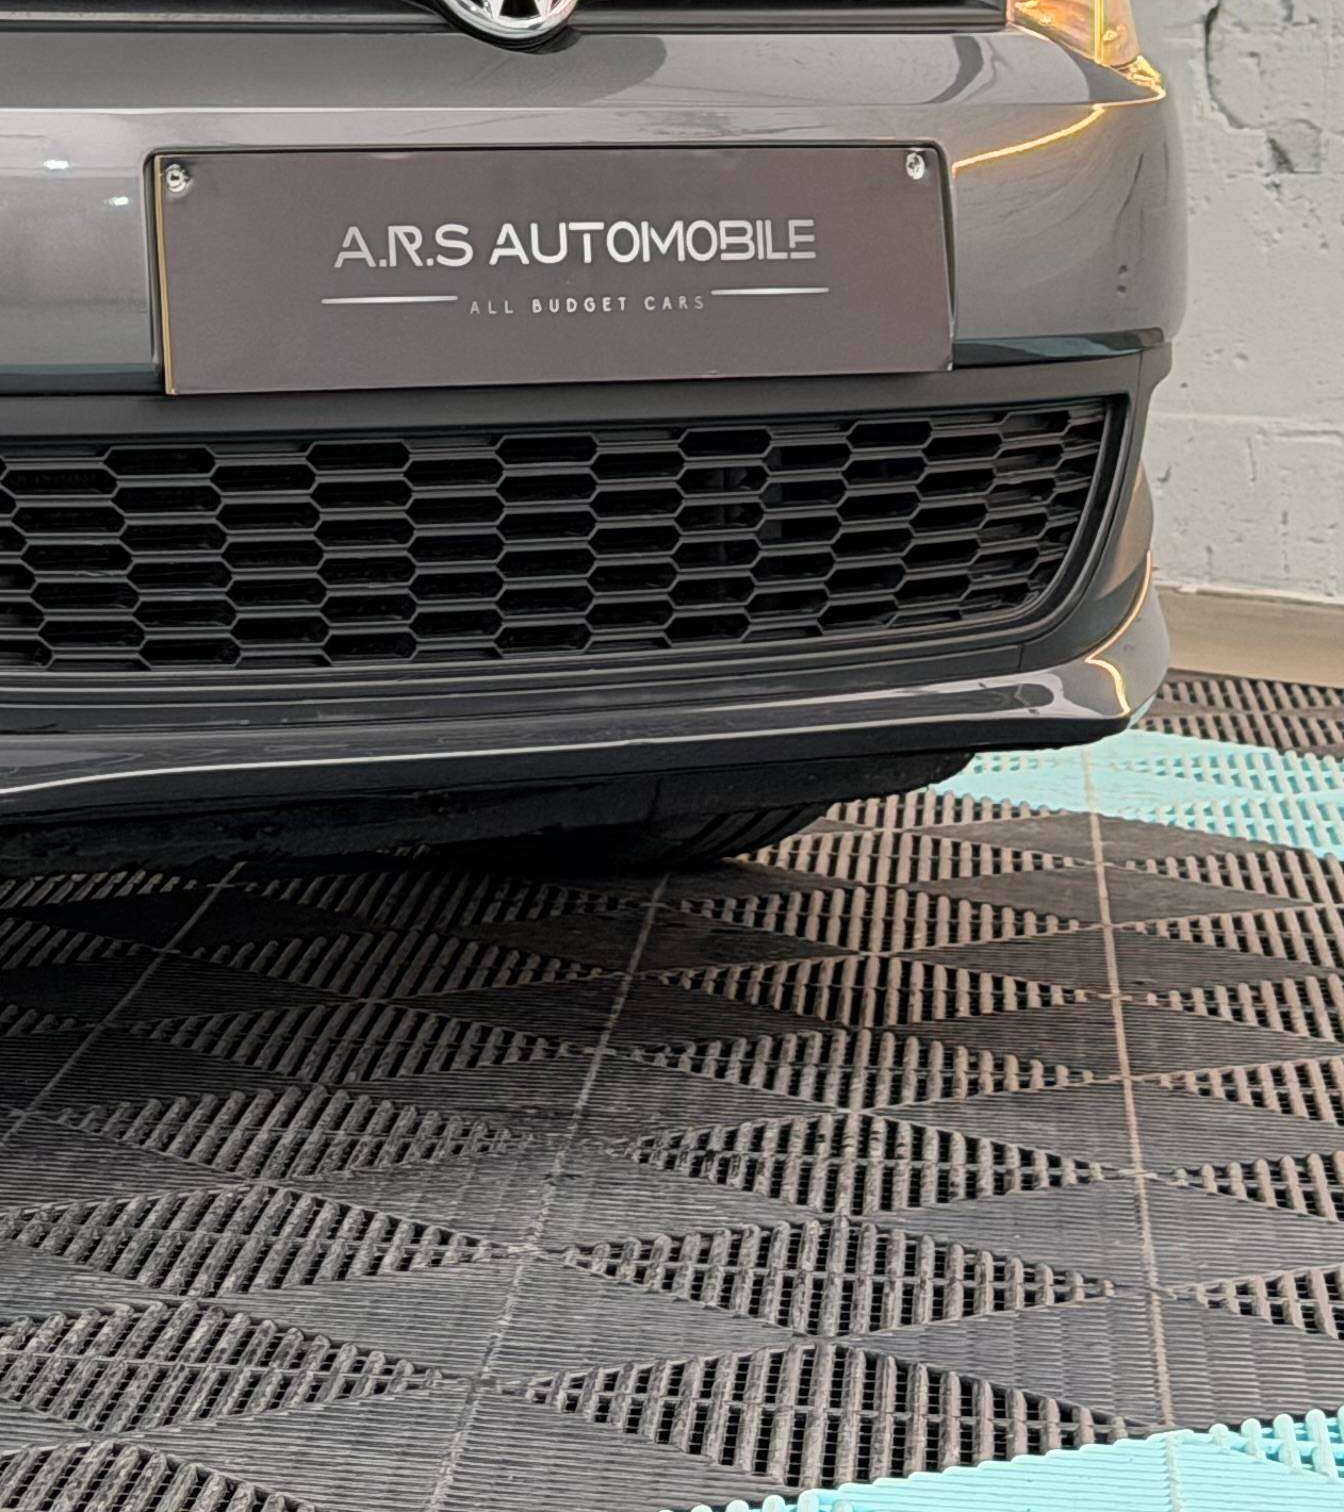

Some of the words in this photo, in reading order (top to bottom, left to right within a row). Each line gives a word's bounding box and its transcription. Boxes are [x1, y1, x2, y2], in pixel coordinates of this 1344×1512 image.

[333, 223, 474, 269] A.R.S
[488, 219, 816, 265] AUTOMOBILE
[469, 300, 514, 315] ALL
[531, 296, 628, 314] BUDGET
[644, 295, 705, 311] CARS
